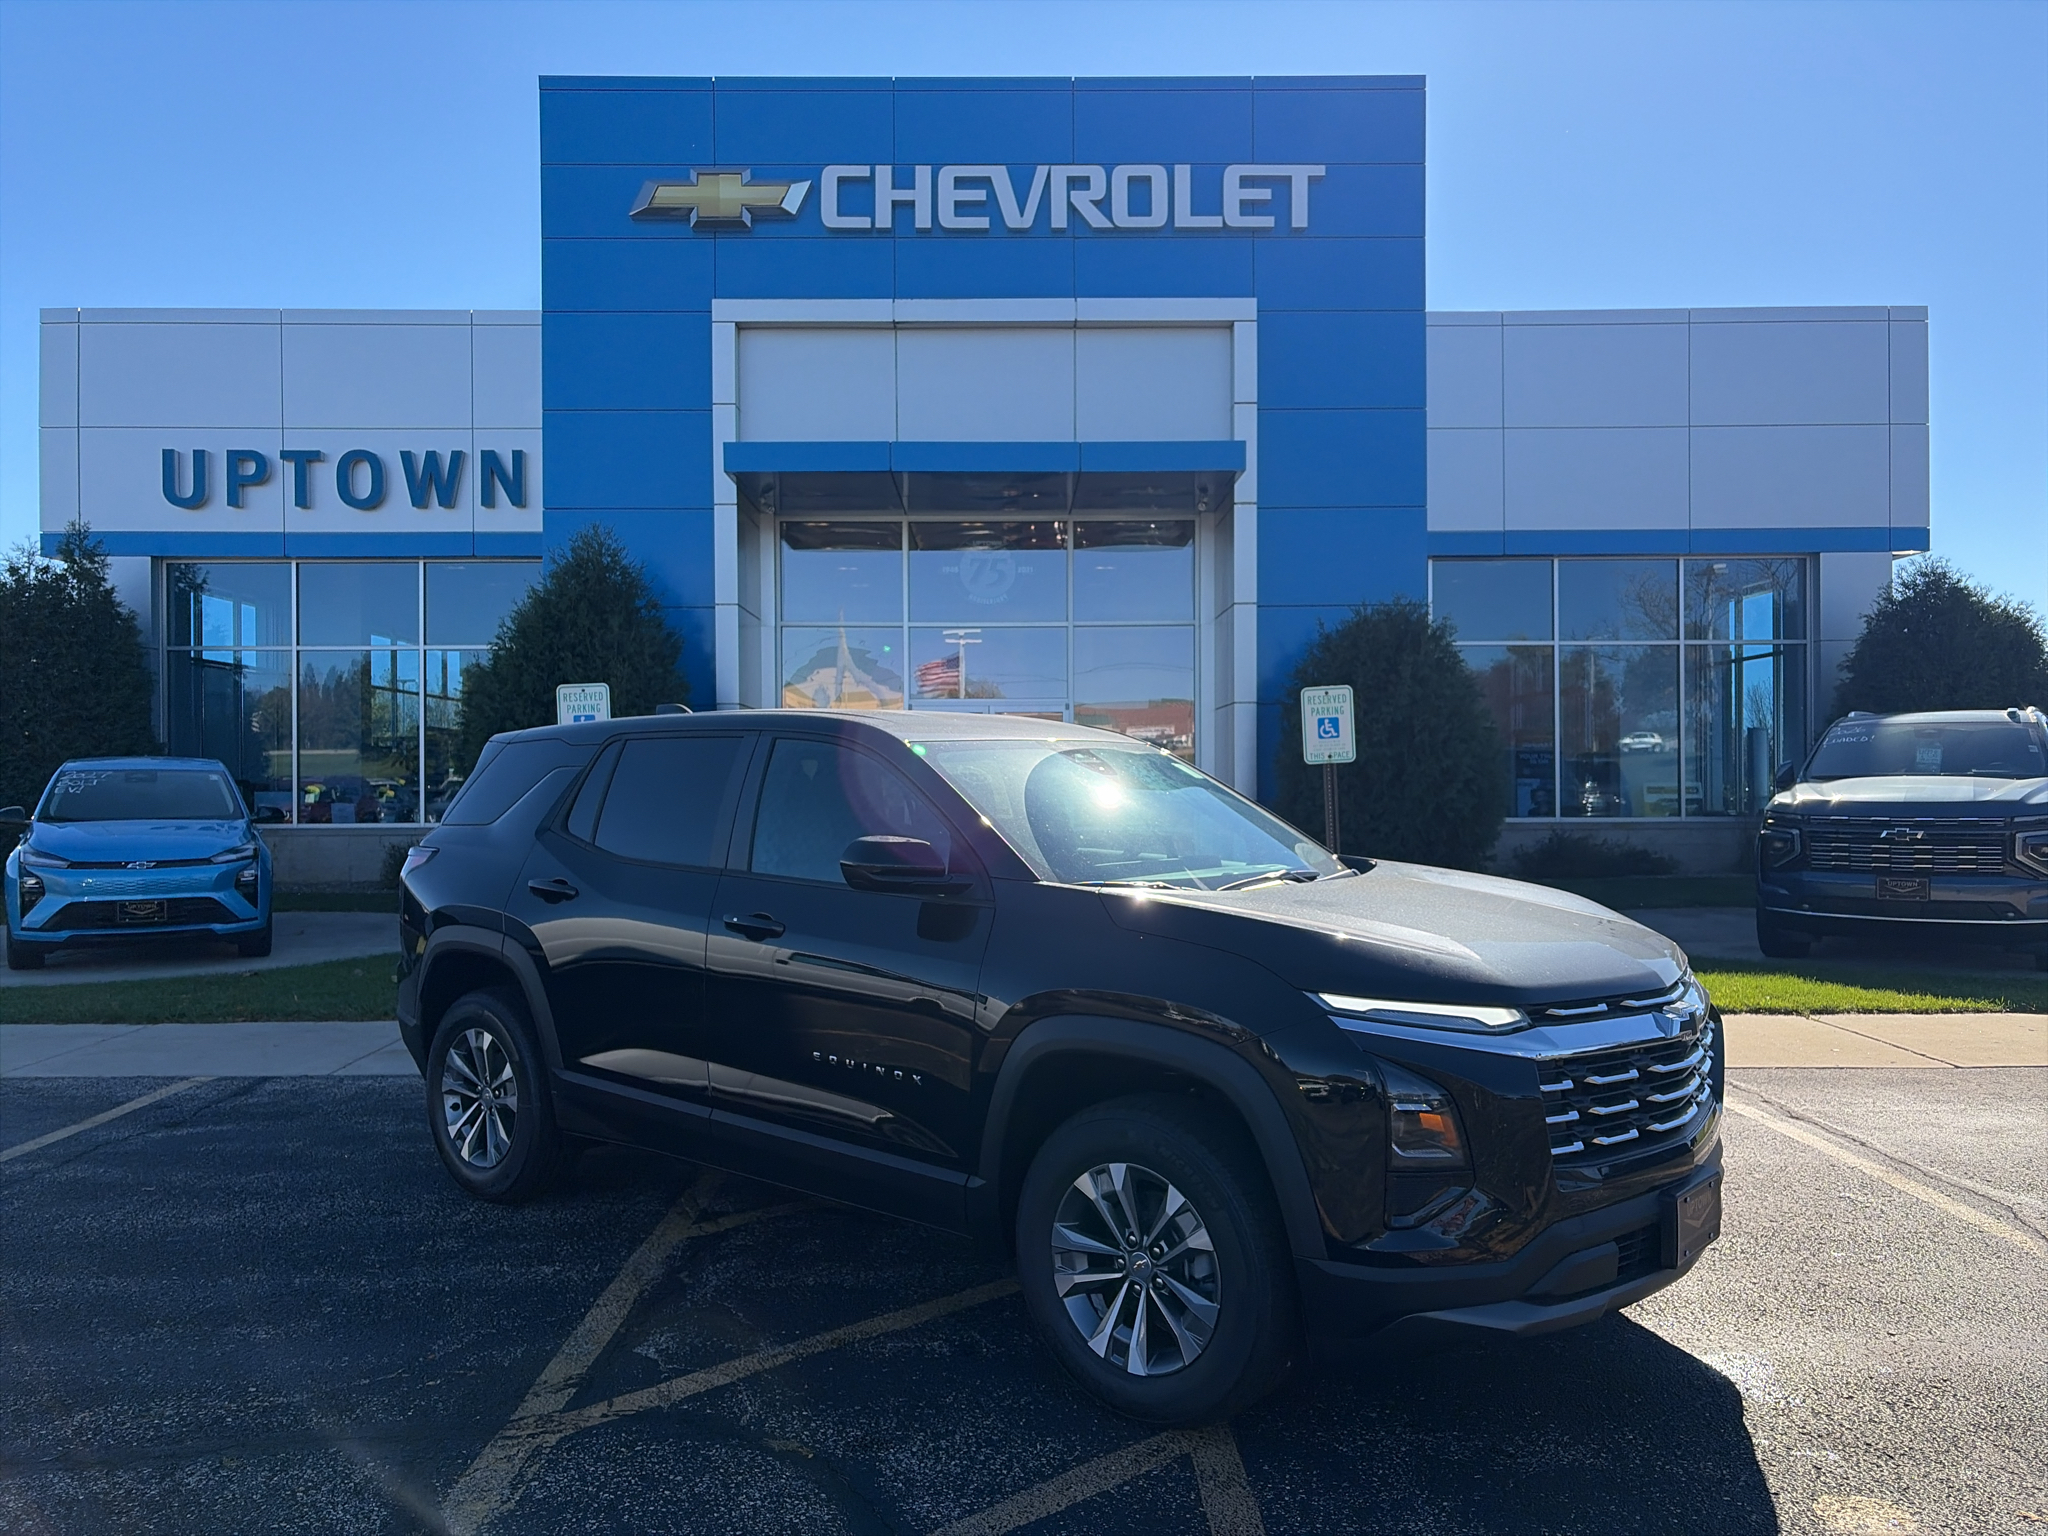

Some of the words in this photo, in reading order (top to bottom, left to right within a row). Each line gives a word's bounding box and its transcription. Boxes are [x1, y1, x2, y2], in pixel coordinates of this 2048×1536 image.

[820, 164, 1326, 230] CHEVROLET
[161, 448, 526, 510] UPTOWN
[969, 558, 1009, 586] 75
[563, 691, 603, 703] RESERVED
[1307, 693, 1347, 705] RESERVED
[566, 703, 601, 714] PARKING
[1310, 705, 1345, 717] PARKING
[1310, 752, 1325, 760] THIS
[812, 1051, 922, 1086] EQUINOX
[1688, 1190, 1712, 1213] UPTOWN
